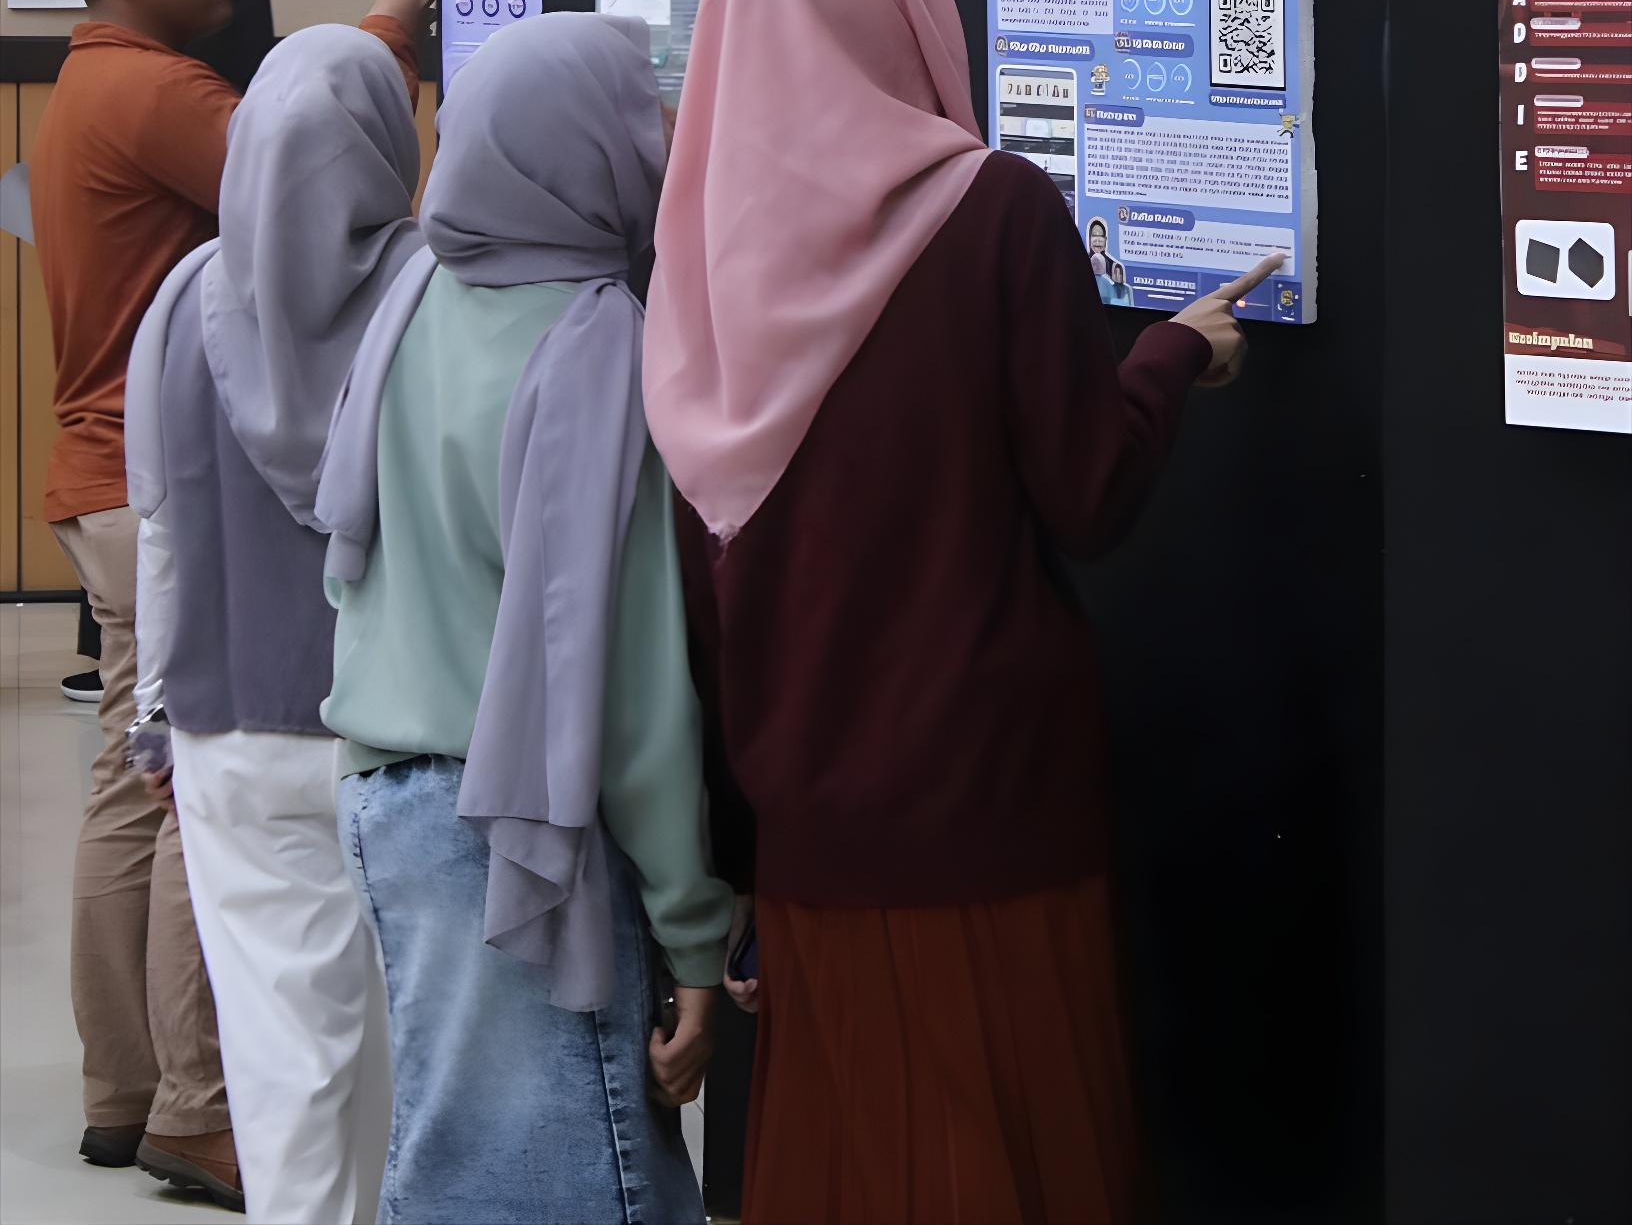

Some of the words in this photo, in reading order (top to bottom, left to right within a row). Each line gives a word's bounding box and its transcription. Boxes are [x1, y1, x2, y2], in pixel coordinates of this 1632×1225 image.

[1513, 22, 1526, 44] D
[1514, 62, 1527, 83] D
[1517, 104, 1525, 125] I
[1515, 150, 1529, 171] E
